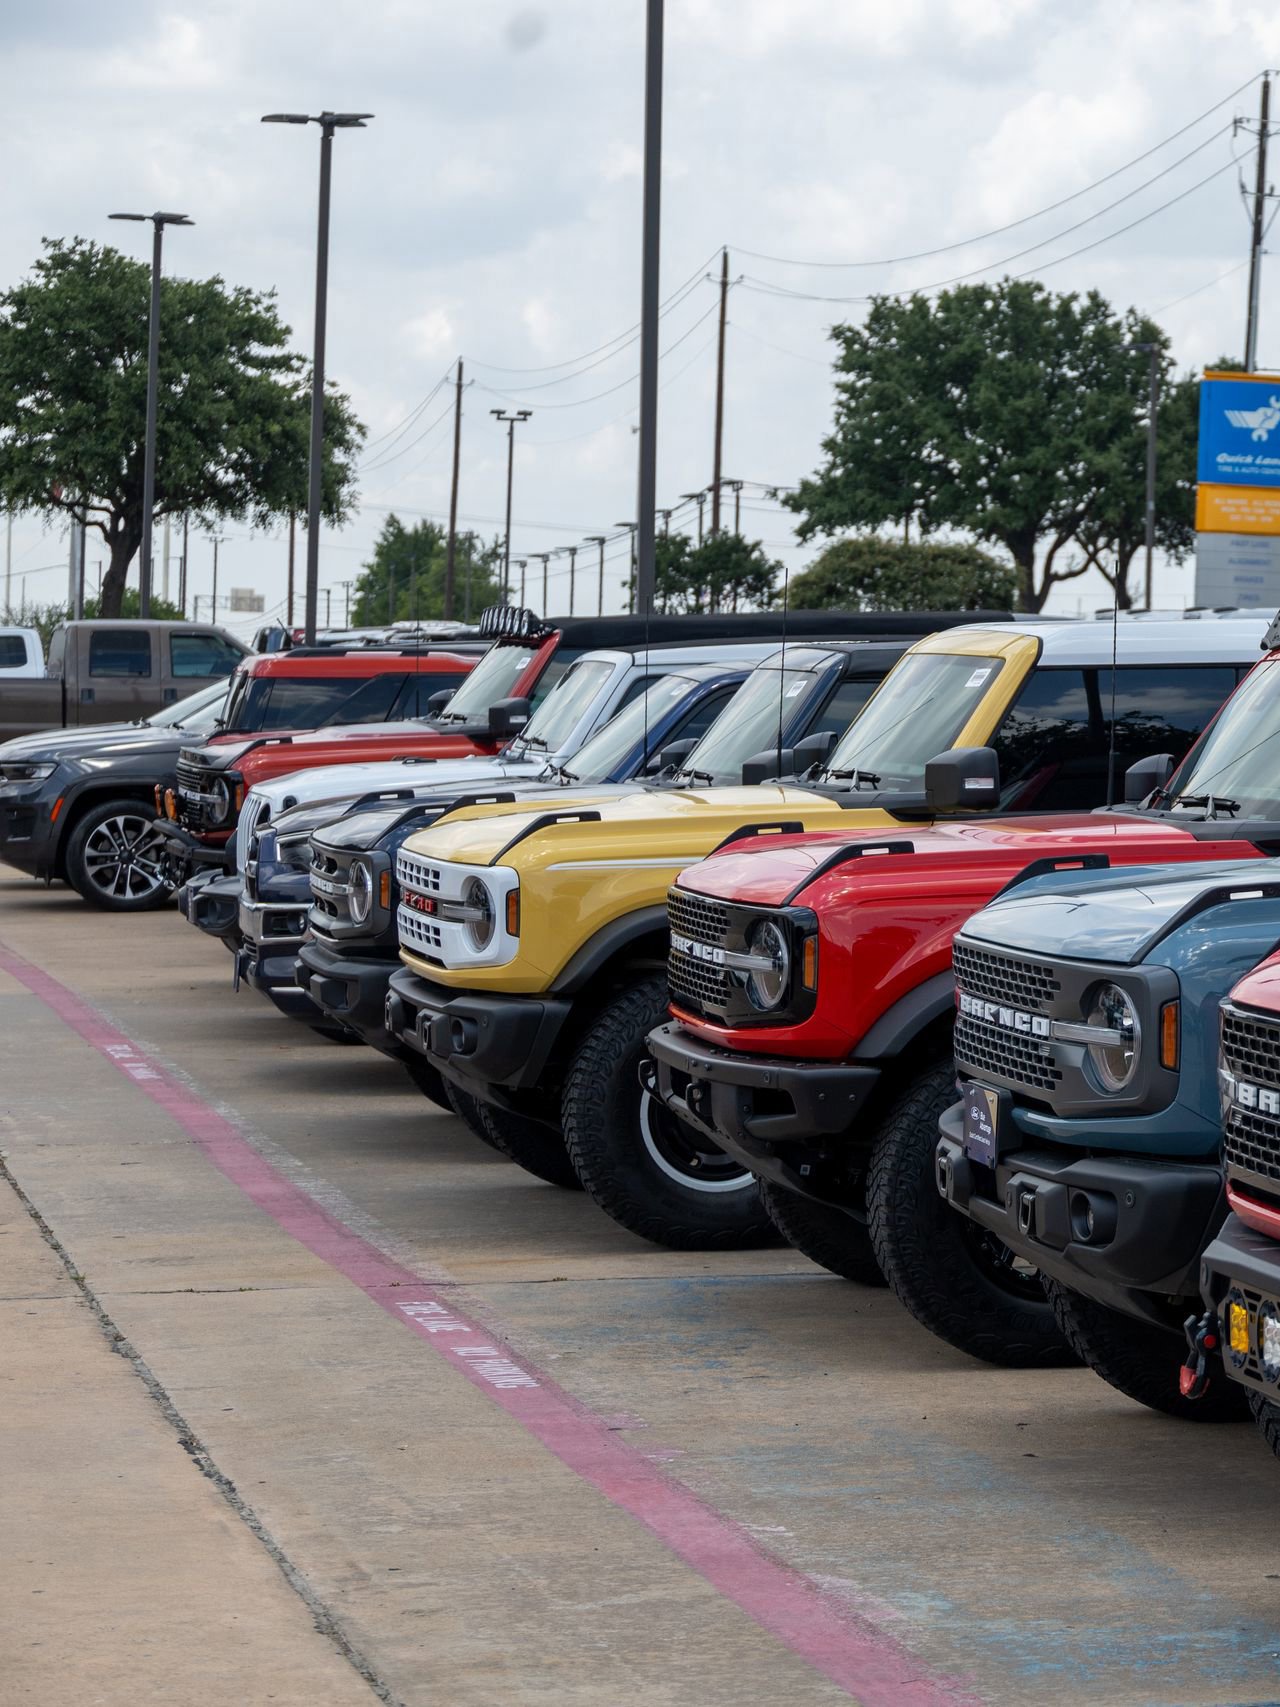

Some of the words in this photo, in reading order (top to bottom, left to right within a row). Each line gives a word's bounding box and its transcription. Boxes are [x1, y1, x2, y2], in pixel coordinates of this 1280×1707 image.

[1216, 452, 1254, 464] Quick
[960, 993, 1050, 1037] BRONCO
[395, 1301, 449, 1316] FIRE
[414, 1316, 473, 1333] LANE
[449, 1346, 500, 1357] NO
[464, 1358, 541, 1389] PARKING
